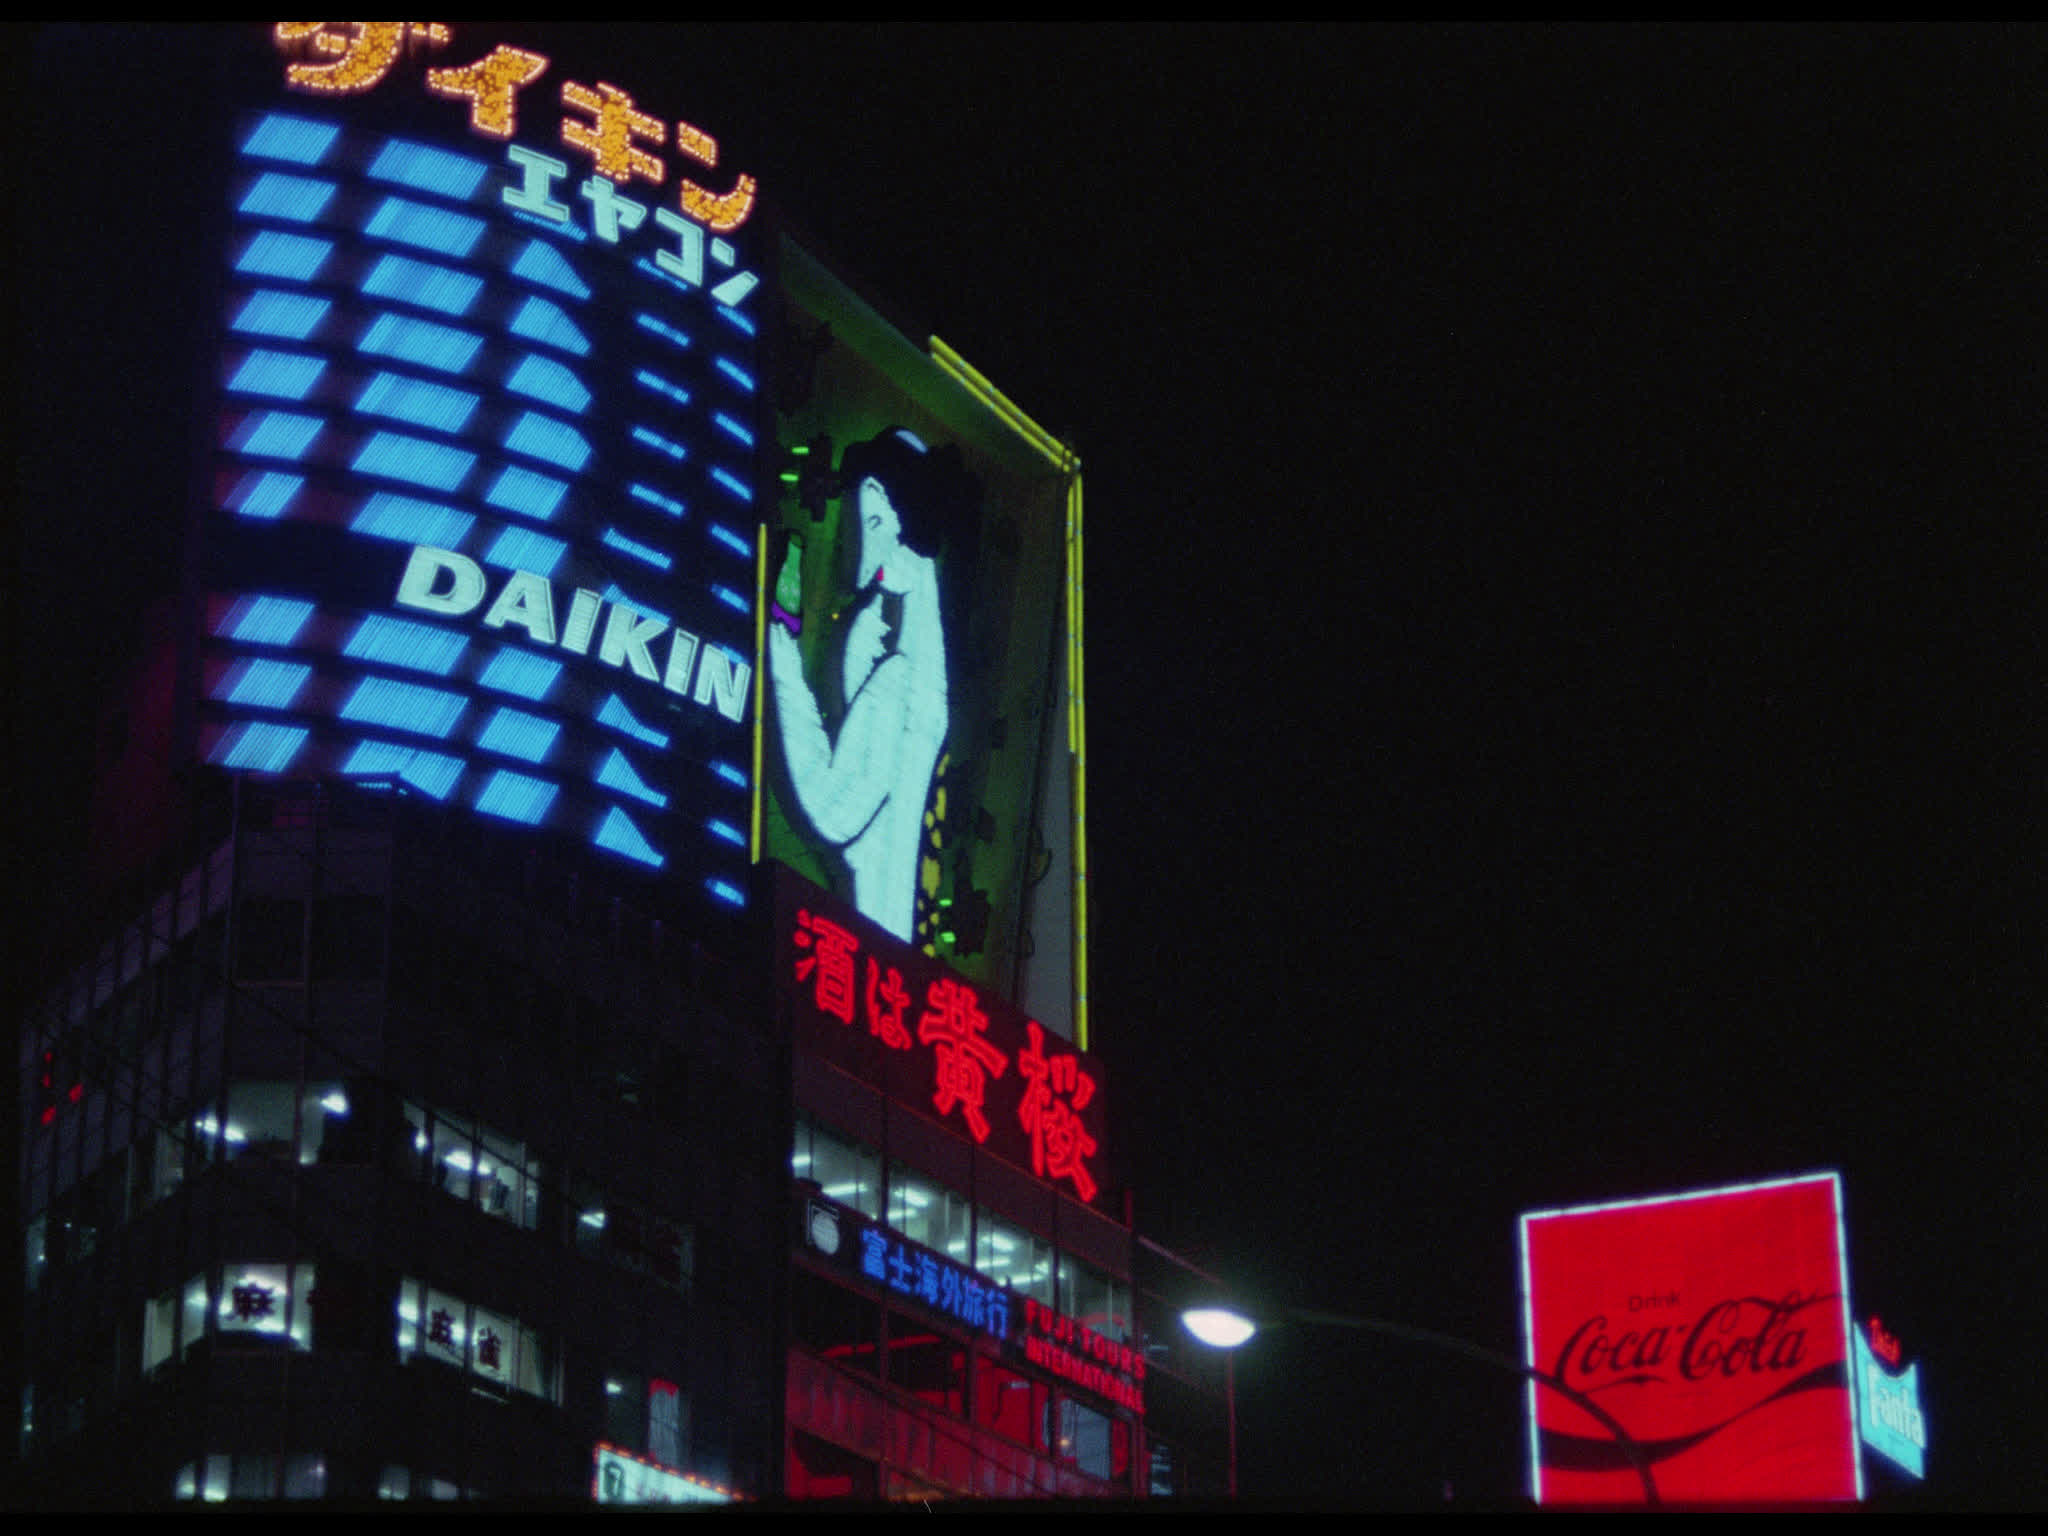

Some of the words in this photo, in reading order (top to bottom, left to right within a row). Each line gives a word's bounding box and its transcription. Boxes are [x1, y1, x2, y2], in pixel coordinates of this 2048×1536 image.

[501, 144, 759, 307] エヤコン
[395, 545, 752, 724] DAIKIN
[861, 1228, 1010, 1340] 富士海外旅行
[1628, 1292, 1681, 1312] Drink
[1025, 1298, 1074, 1345] FUJI
[1081, 1327, 1146, 1380] TOURS
[1556, 1292, 1828, 1388] Coca-Cola
[1867, 1363, 1926, 1449] Fanta
